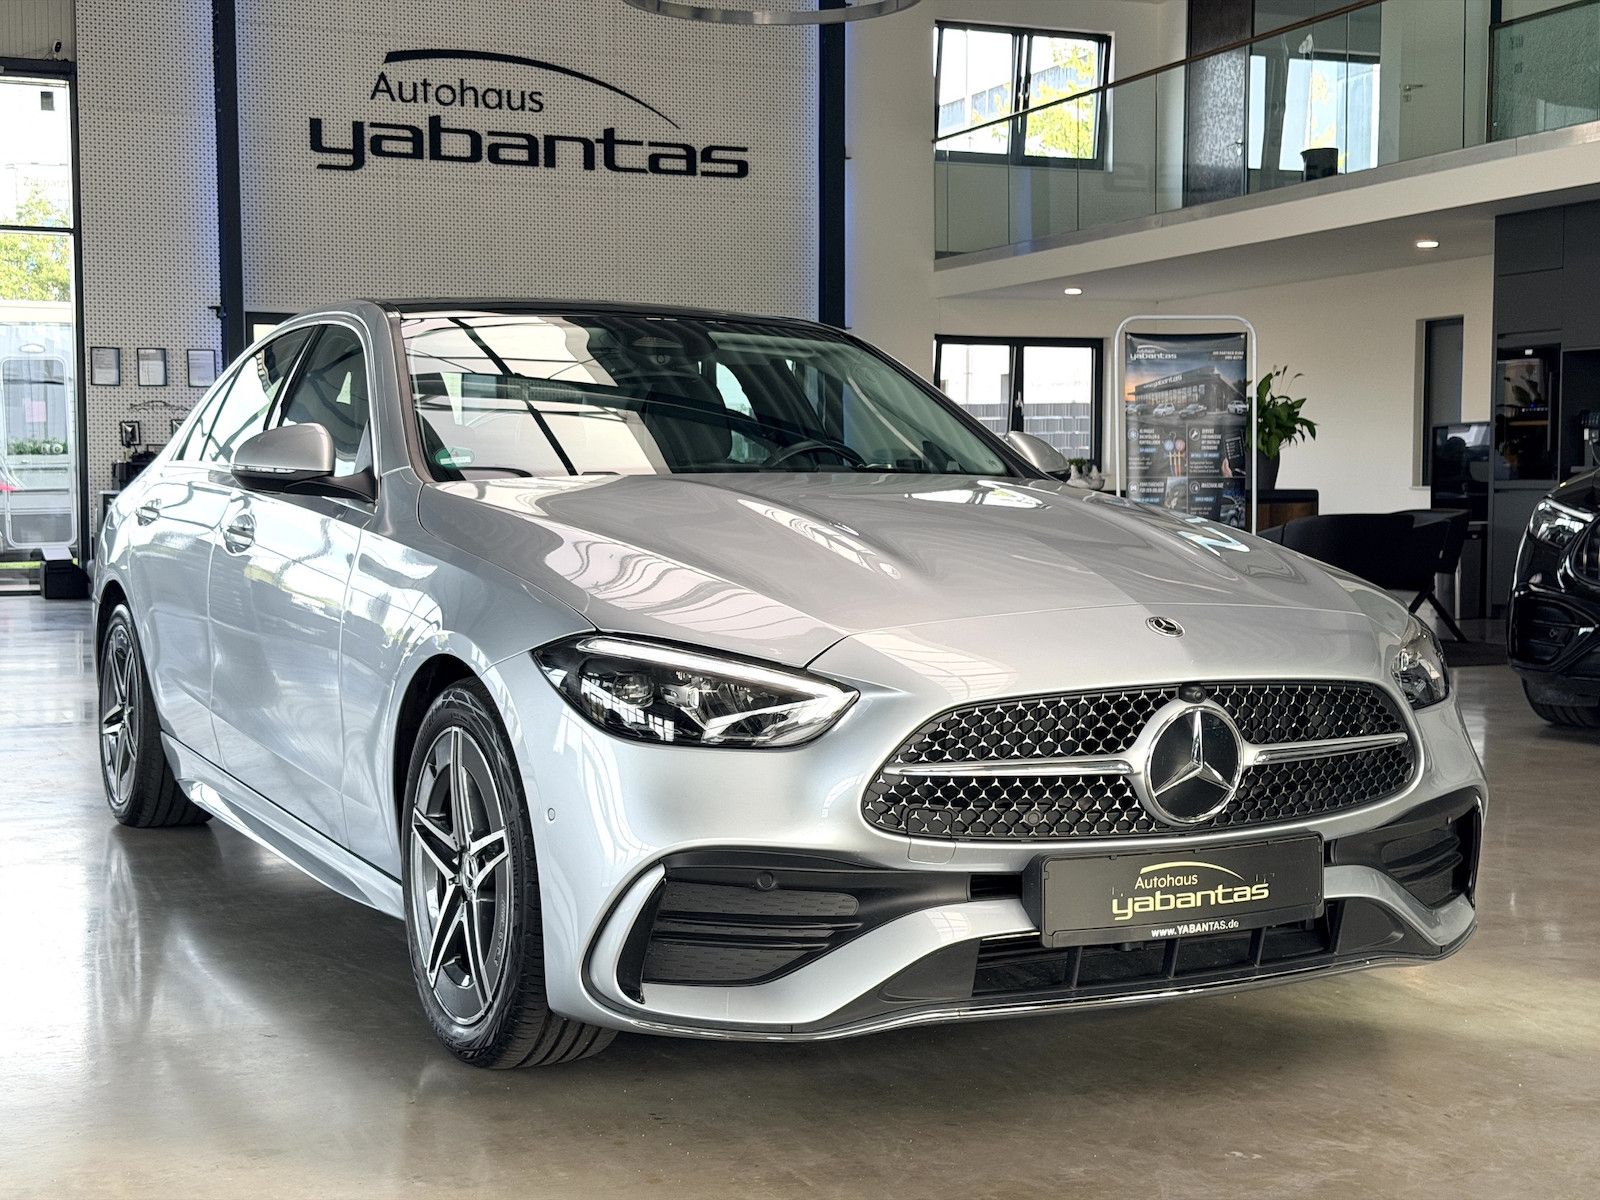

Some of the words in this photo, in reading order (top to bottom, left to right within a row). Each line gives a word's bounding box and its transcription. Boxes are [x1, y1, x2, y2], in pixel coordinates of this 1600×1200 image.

[370, 71, 545, 113] Autohaus
[309, 115, 749, 178] yabantas
[1130, 352, 1177, 361] yabantas
[1134, 873, 1198, 890] Autohaus
[1112, 883, 1269, 920] yabantas
[1151, 920, 1239, 937] www.YABANTAS.de
